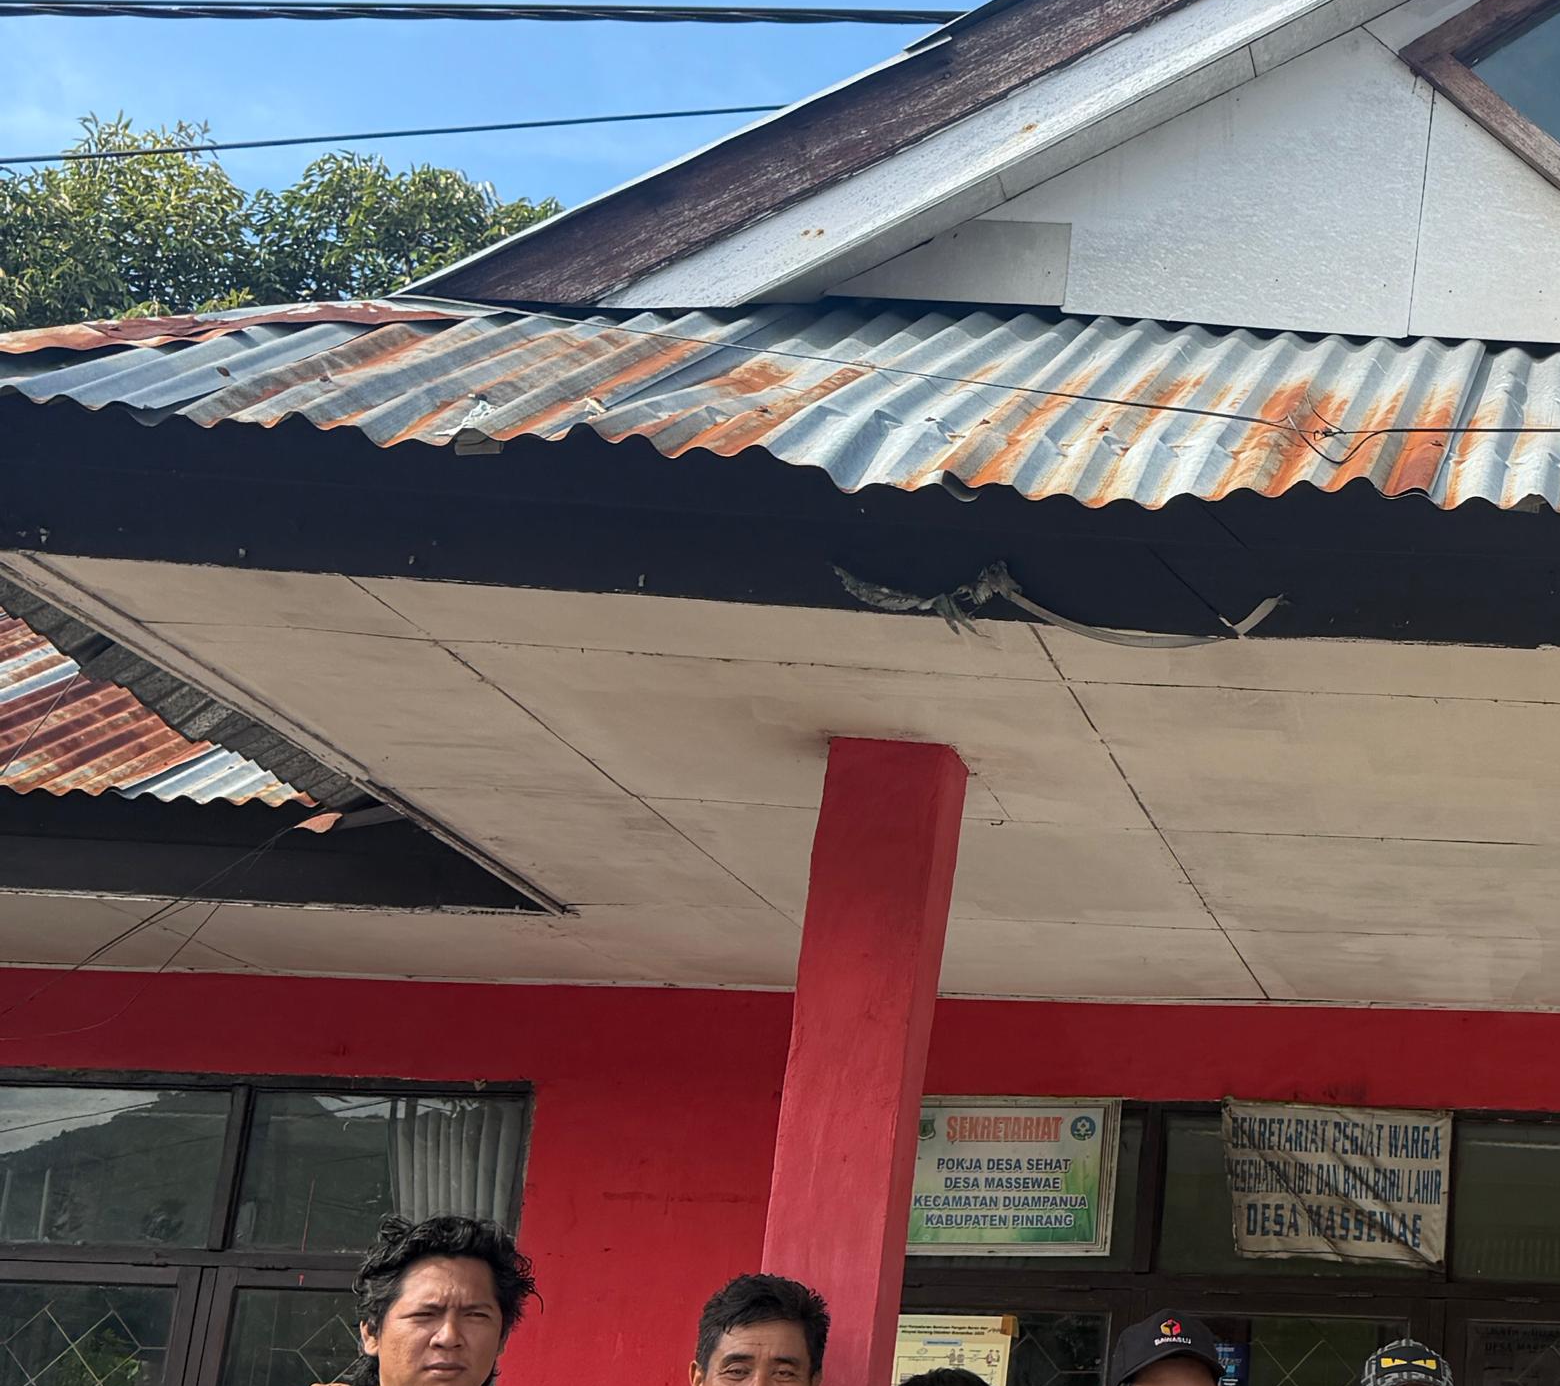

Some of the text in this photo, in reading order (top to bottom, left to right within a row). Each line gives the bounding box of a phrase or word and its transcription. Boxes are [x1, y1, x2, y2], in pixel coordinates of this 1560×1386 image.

[946, 1115, 1064, 1142] SEKRETARIAT
[1231, 1116, 1328, 1153] SEKRETARIAT
[1388, 1125, 1441, 1160] WARGA
[936, 1157, 1071, 1173] POKJA DESA SEHAT
[944, 1176, 1060, 1191] DESA MASSEWAE
[1294, 1160, 1312, 1195] IBU
[1315, 1162, 1339, 1197] DAN
[1372, 1166, 1404, 1202] BARU
[1406, 1167, 1443, 1205] LAHIR
[913, 1195, 1088, 1210] KECAMATAN DUAMPANUA
[925, 1213, 1074, 1228] KABUPATEN PINRANG
[1246, 1202, 1423, 1249] DESA MASSEWAE
[1154, 1336, 1192, 1346] BAWASLU
